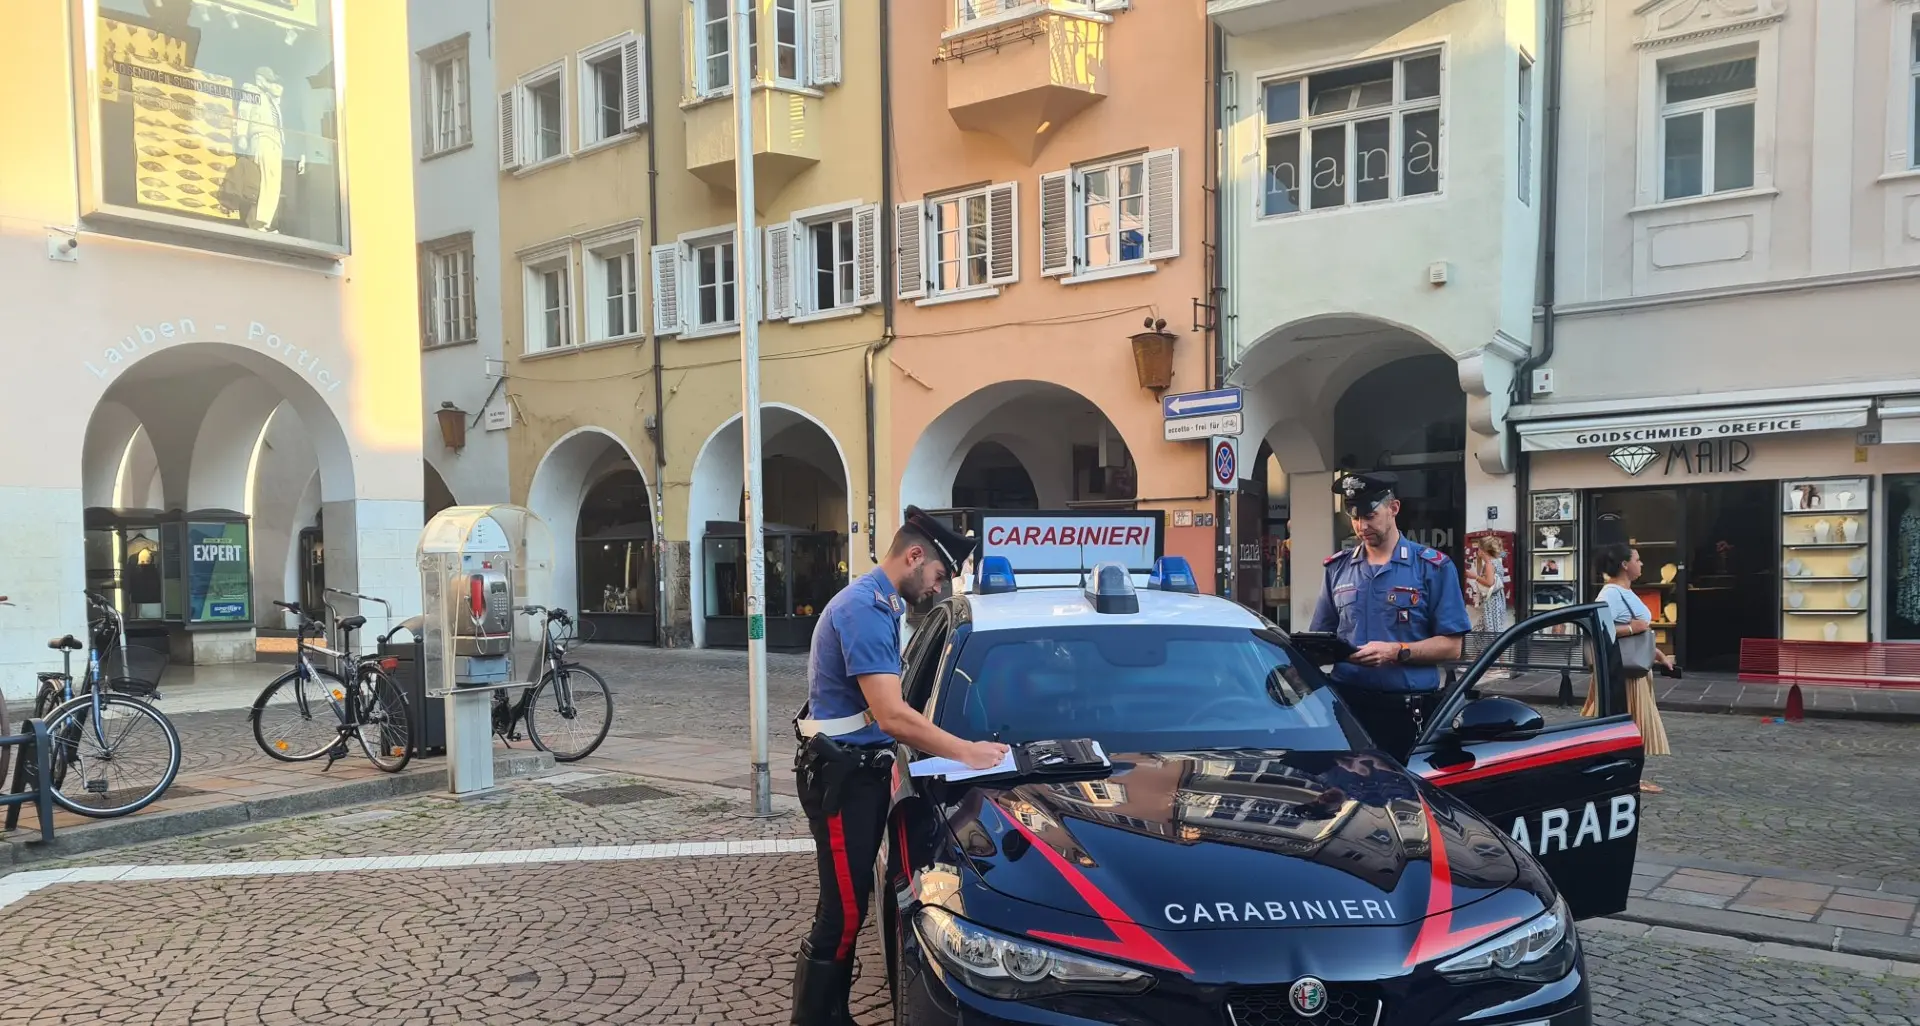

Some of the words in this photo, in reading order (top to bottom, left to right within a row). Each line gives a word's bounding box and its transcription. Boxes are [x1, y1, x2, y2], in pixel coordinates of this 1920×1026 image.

[1267, 129, 1439, 195] nanà
[84, 316, 197, 380] Lauben
[247, 320, 342, 393] Portici
[1195, 423, 1207, 431] frei
[1209, 422, 1220, 430] für
[1576, 426, 1702, 445] GOLDSCHMIED
[1718, 419, 1802, 435] OREFICE
[1663, 438, 1751, 476] MAIR
[987, 525, 1151, 546] CARABINIERI
[193, 544, 242, 562] EXPERT
[1510, 794, 1637, 855] ARAB
[1163, 899, 1397, 924] CARABINIERI
